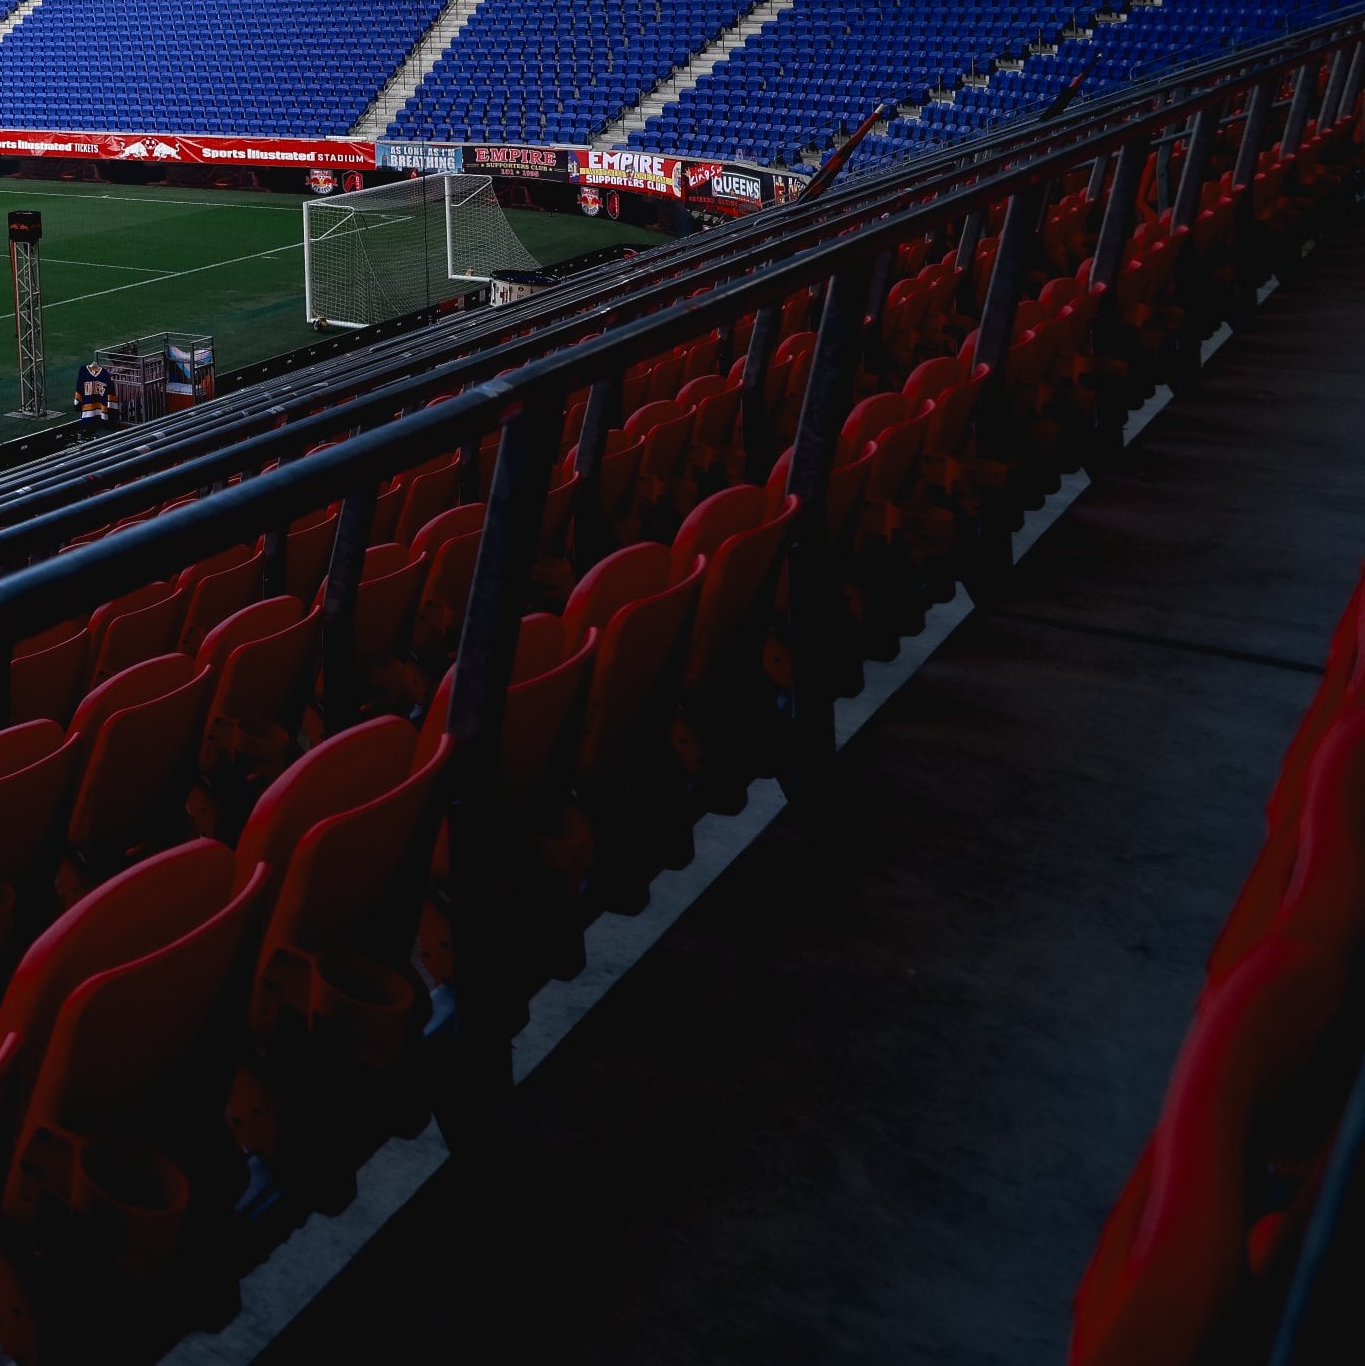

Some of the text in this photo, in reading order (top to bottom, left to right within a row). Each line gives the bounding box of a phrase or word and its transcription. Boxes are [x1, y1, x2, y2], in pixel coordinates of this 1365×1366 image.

[17, 140, 72, 152] Illustrated
[74, 143, 99, 153] TICKETS
[391, 146, 401, 154] AS
[427, 148, 439, 156] AS
[441, 148, 455, 156] I'M
[201, 148, 364, 163] Sports Illustrated STADIUM
[391, 154, 455, 170] BREATHING
[475, 148, 557, 166] EMPIRE
[589, 152, 665, 176] EMPIRE
[585, 175, 667, 192] SUPPORTERS CLUB
[713, 175, 759, 199] QUEENS
